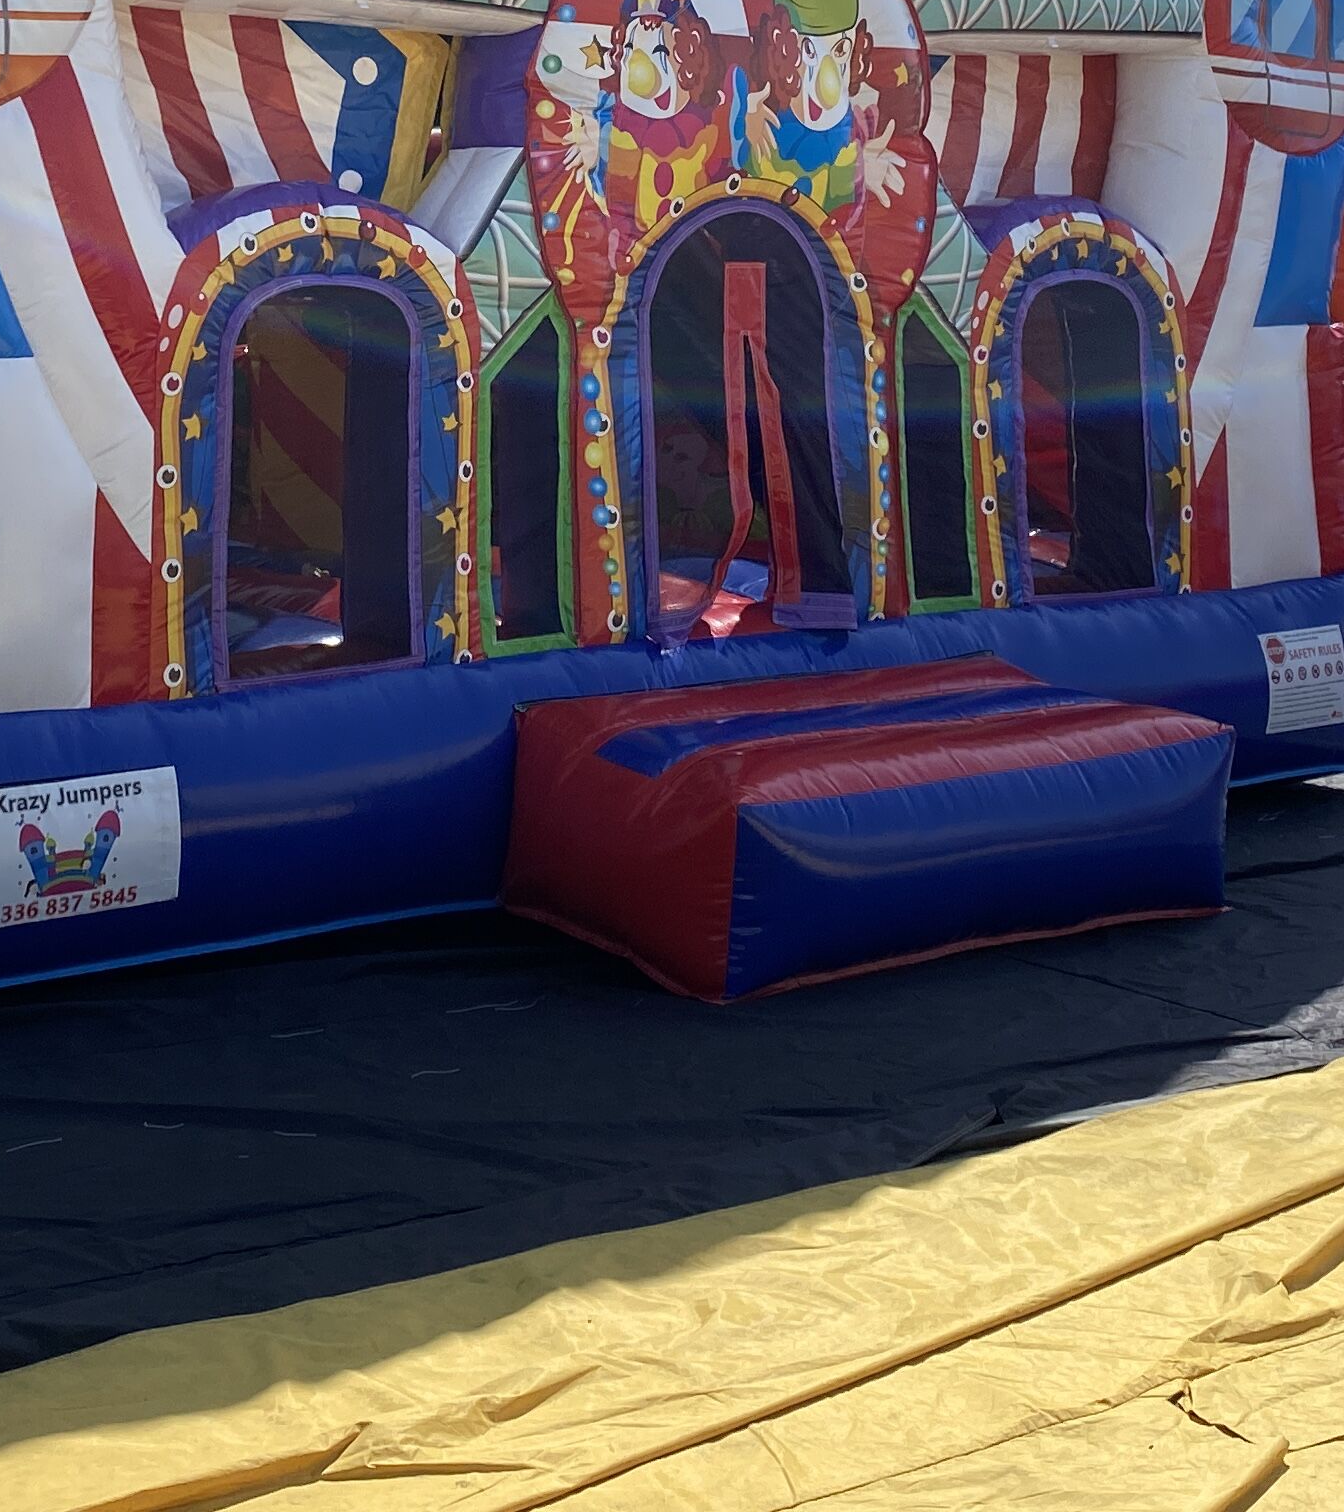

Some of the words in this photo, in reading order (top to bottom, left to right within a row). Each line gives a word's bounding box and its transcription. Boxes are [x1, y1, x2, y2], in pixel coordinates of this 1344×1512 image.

[1288, 647, 1316, 660] SAFETY
[1318, 644, 1341, 656] RULES
[57, 780, 142, 806] Jumpers
[0, 902, 38, 923] 336
[46, 895, 83, 915] 837
[89, 886, 138, 909] 5845
